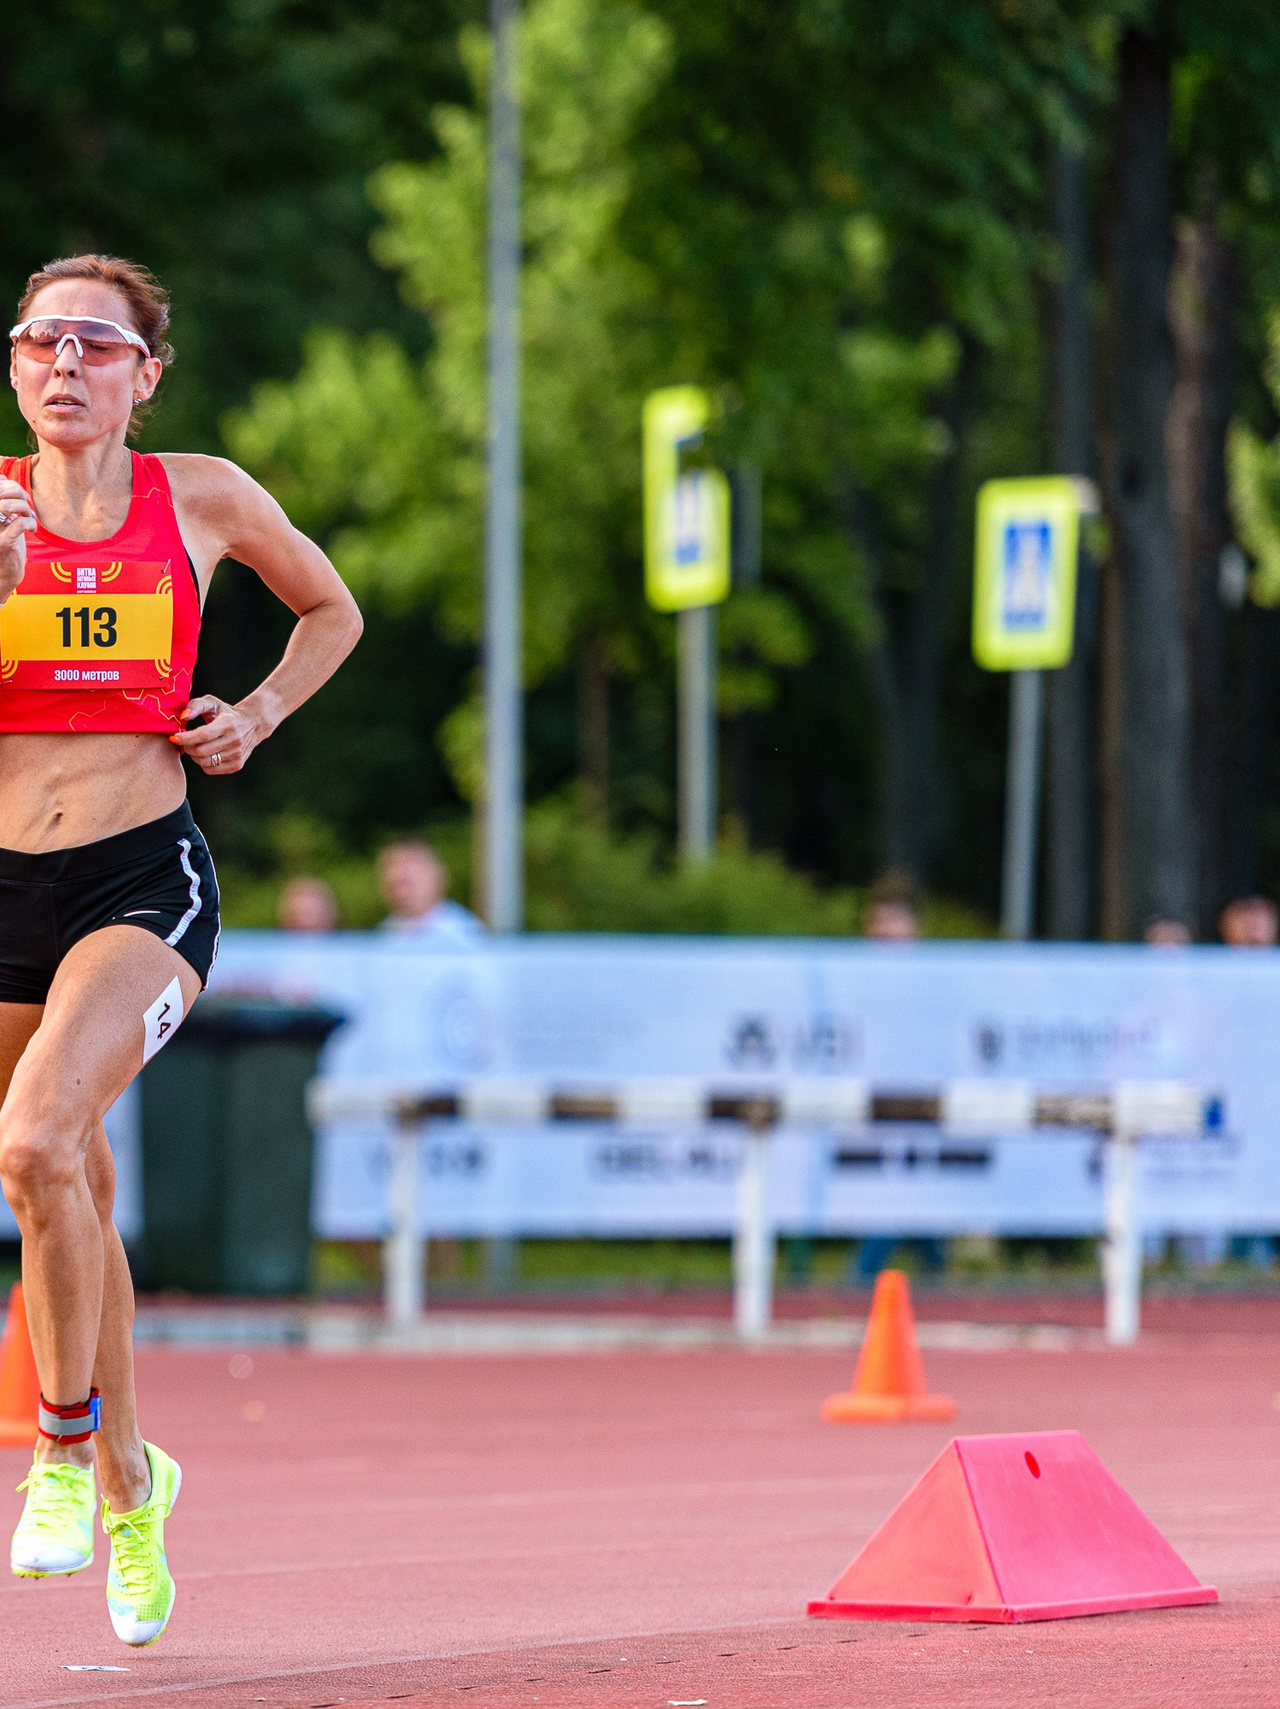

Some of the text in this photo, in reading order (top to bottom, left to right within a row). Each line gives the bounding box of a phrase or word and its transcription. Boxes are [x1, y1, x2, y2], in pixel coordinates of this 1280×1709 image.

[55, 606, 118, 648] 113
[54, 669, 120, 683] 3000 метров
[157, 1002, 171, 1040] 14
